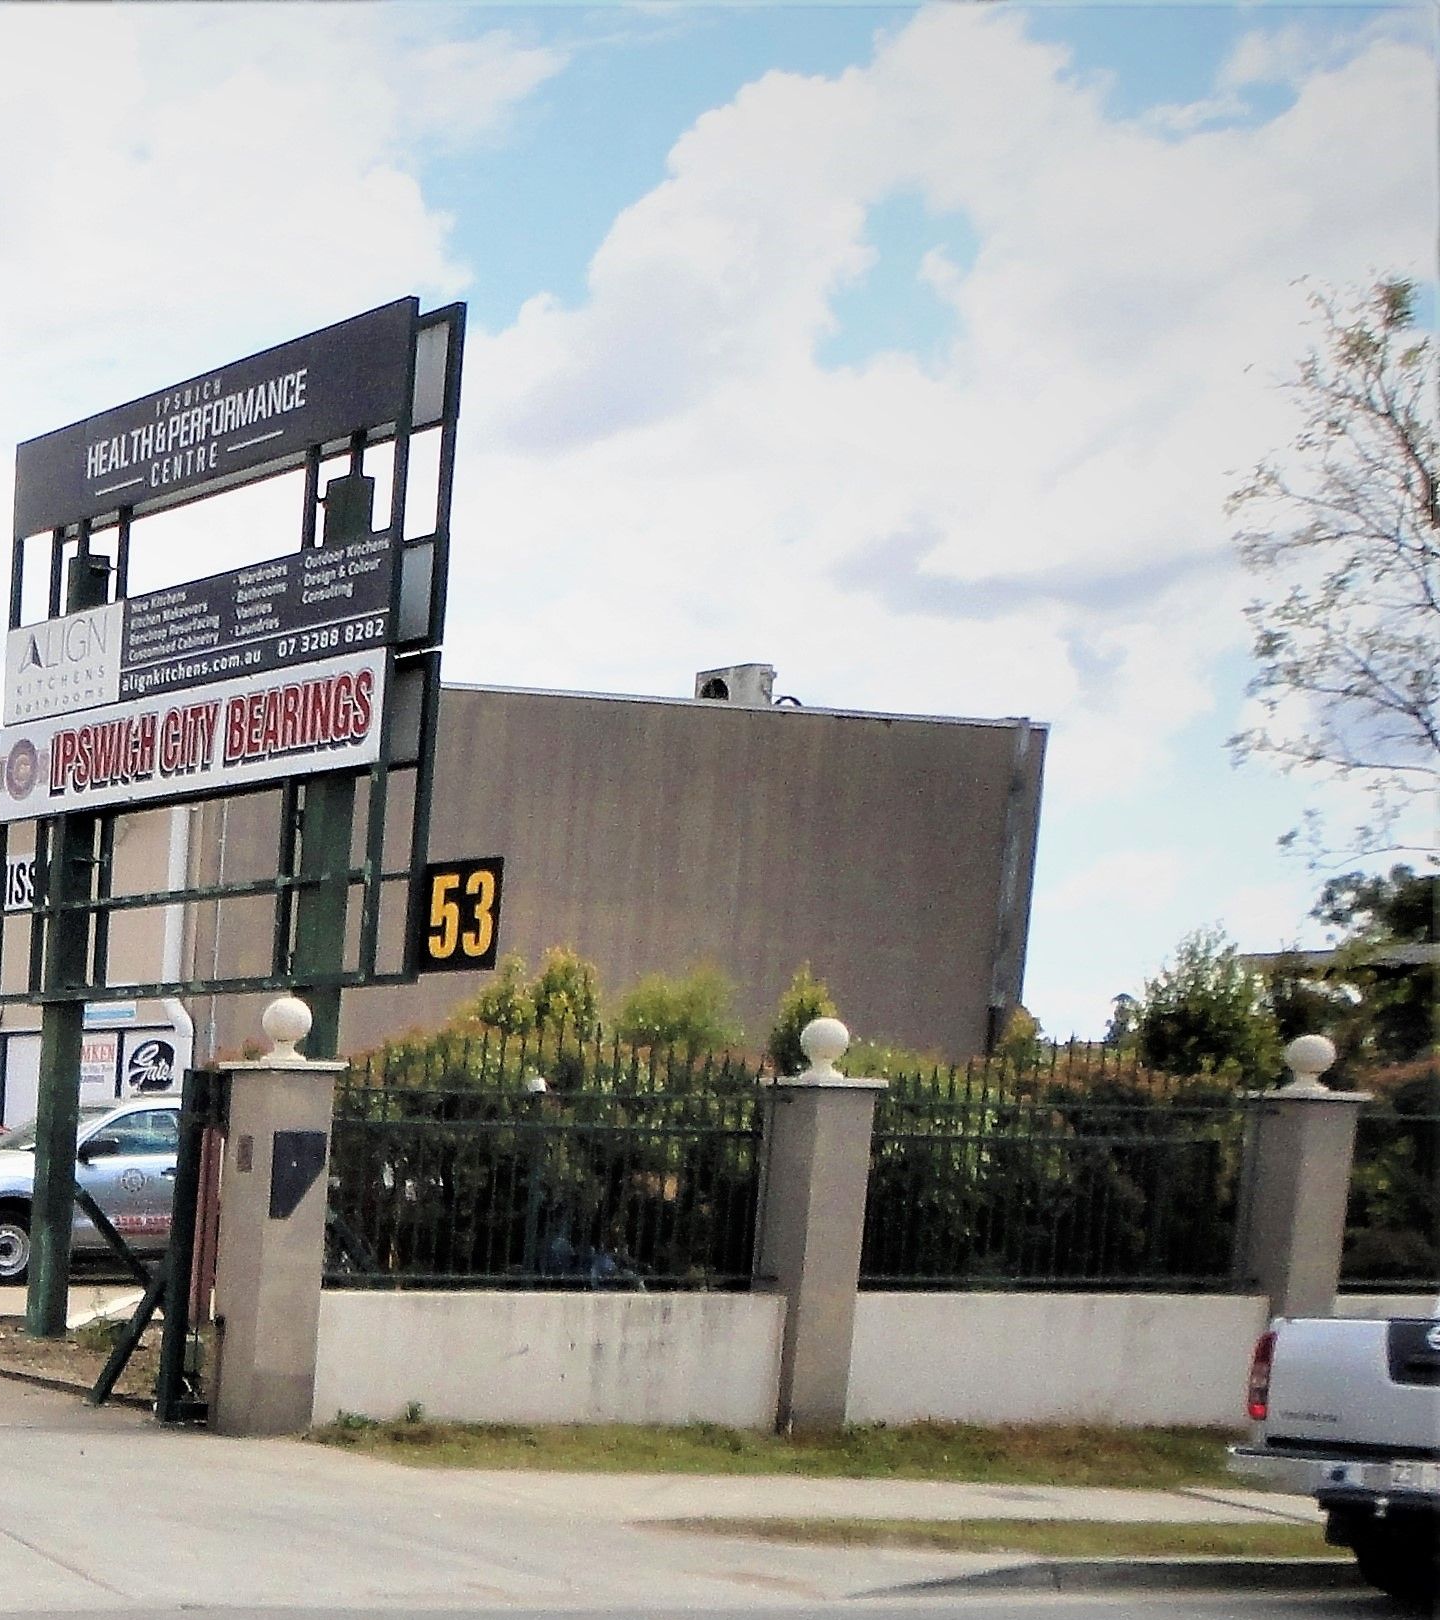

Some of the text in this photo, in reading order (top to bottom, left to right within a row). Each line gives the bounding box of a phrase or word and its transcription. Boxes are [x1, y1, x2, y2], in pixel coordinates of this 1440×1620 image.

[155, 378, 222, 417] IPSWICH
[150, 441, 219, 488] CENTRE
[305, 537, 390, 569] Outdoor Kitchens
[238, 565, 288, 585] Wardrobes
[303, 558, 381, 587] Design & Colour
[151, 592, 187, 609] Kitchens
[236, 582, 288, 603] Bathrooms
[301, 582, 354, 604] Consulting
[18, 612, 109, 674] ALIGN
[234, 617, 280, 637] Laundries
[277, 617, 385, 658] 07 3288 8282
[16, 664, 106, 697] KITCHENS
[121, 649, 262, 693] alignkitchens.com.au
[15, 686, 105, 716] bathrooms
[50, 718, 156, 797] IPSWICH
[159, 701, 220, 778] CITY
[222, 667, 375, 767] BEARINGS
[428, 869, 495, 959] 53
